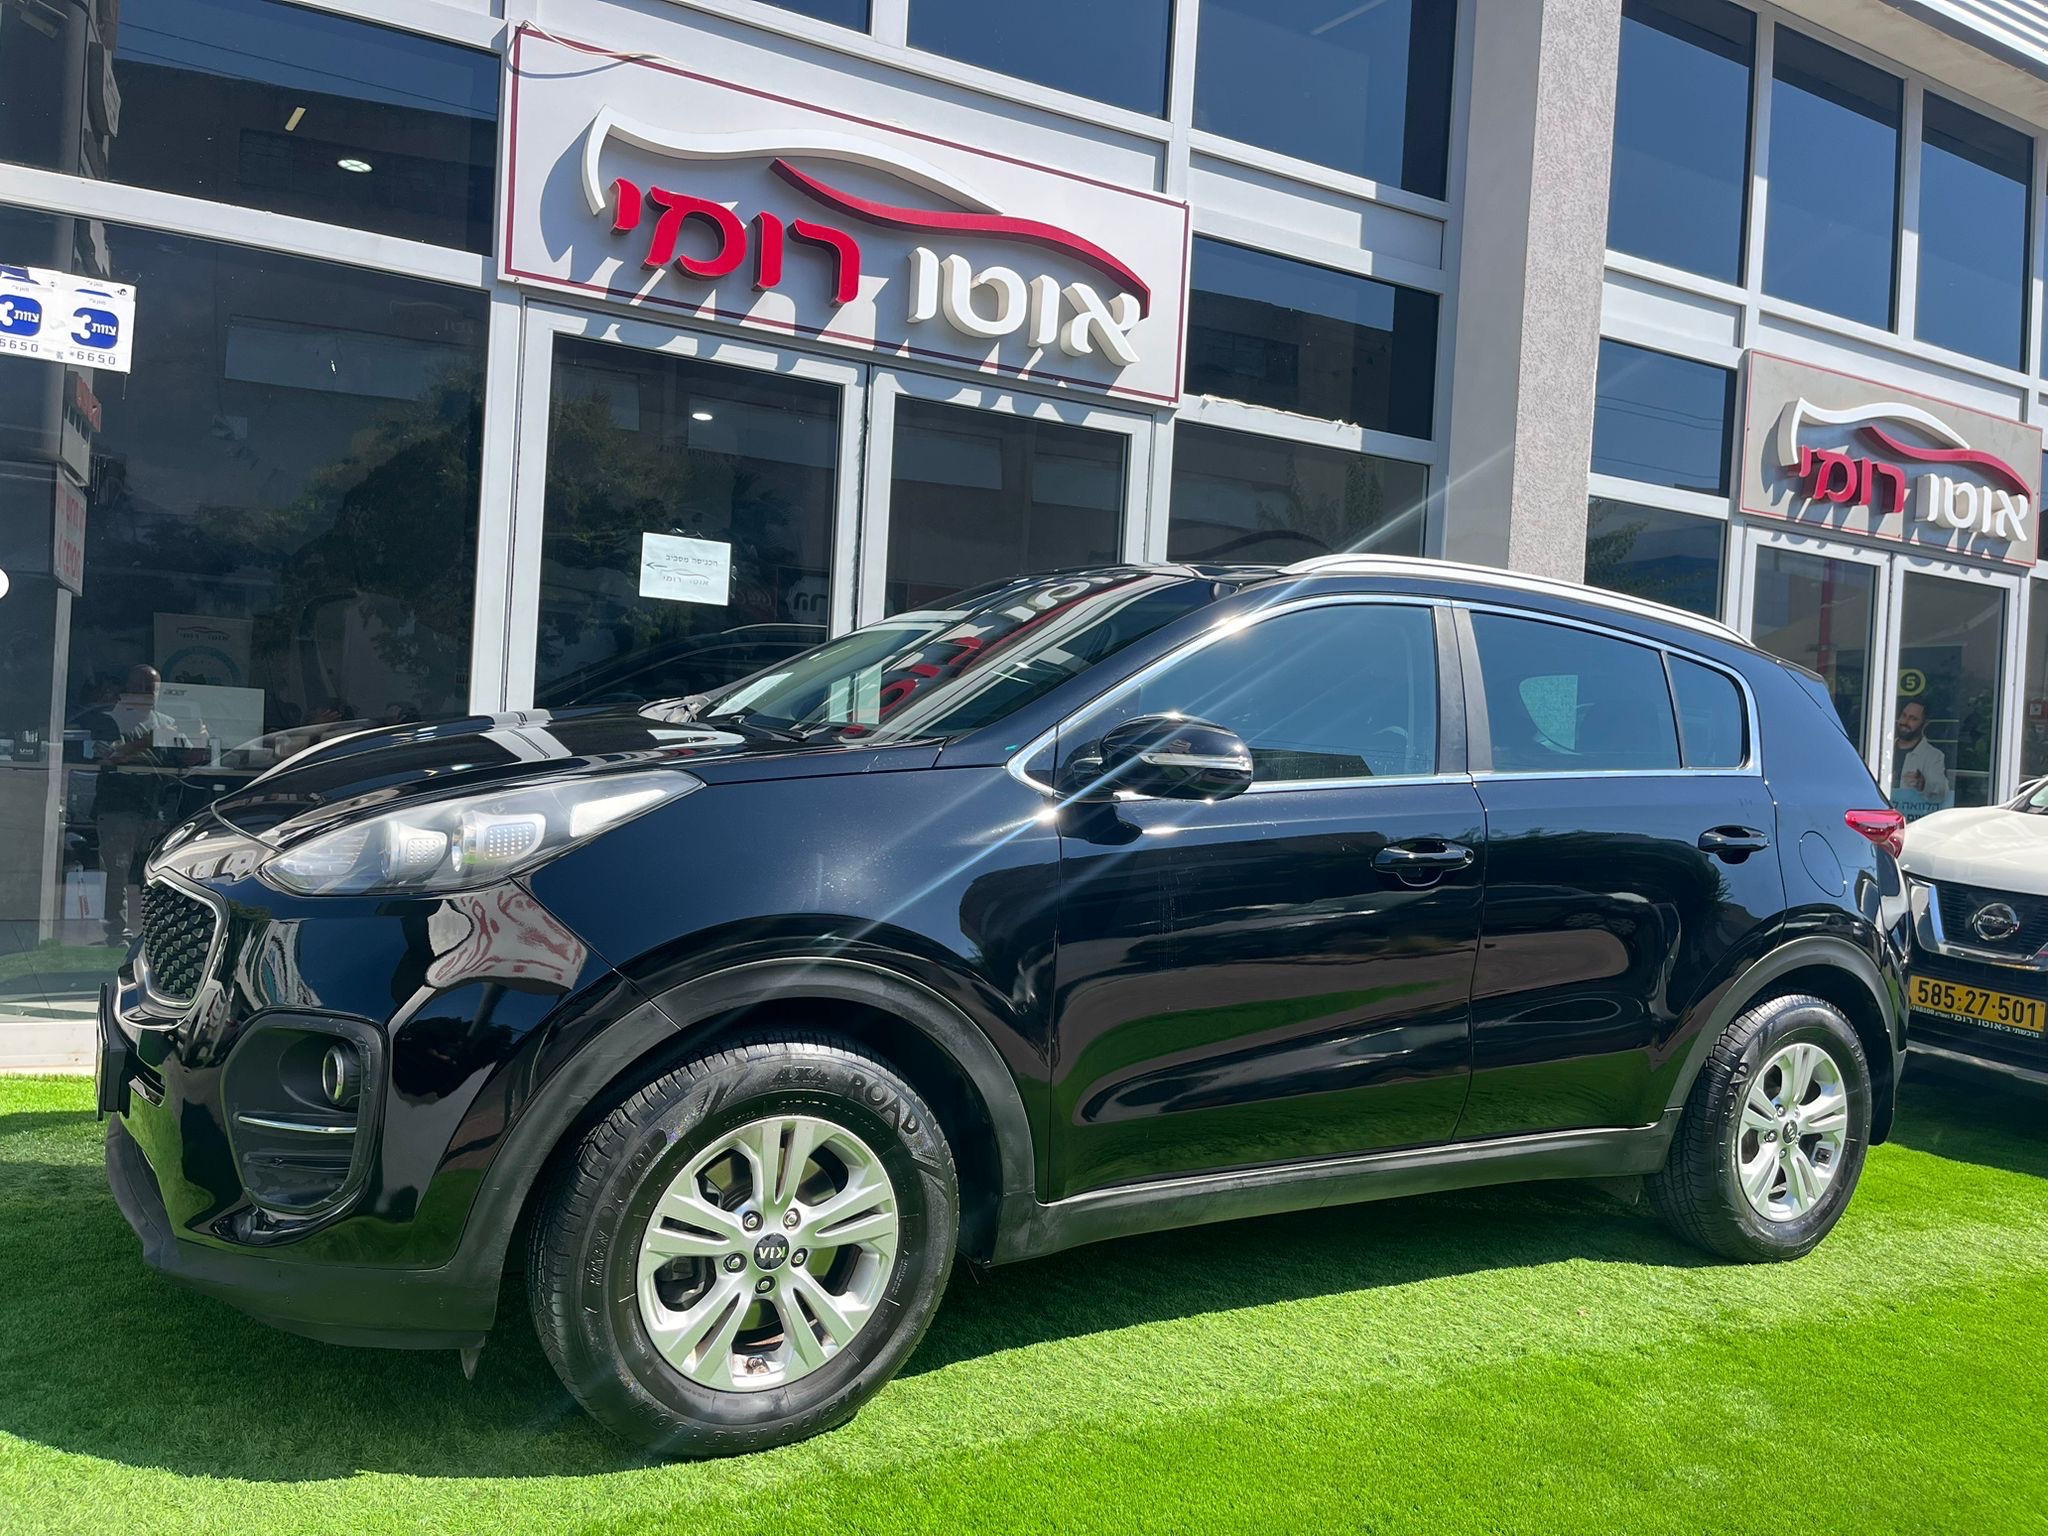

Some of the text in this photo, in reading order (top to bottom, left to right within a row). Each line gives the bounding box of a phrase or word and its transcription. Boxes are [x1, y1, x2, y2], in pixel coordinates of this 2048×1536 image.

[610, 177, 1141, 366] אוטו רומי
[91, 323, 117, 337] צוות
[1798, 444, 2028, 542] אוטו רומי
[849, 1073, 920, 1135] ROAD
[758, 1246, 786, 1259] KIA
